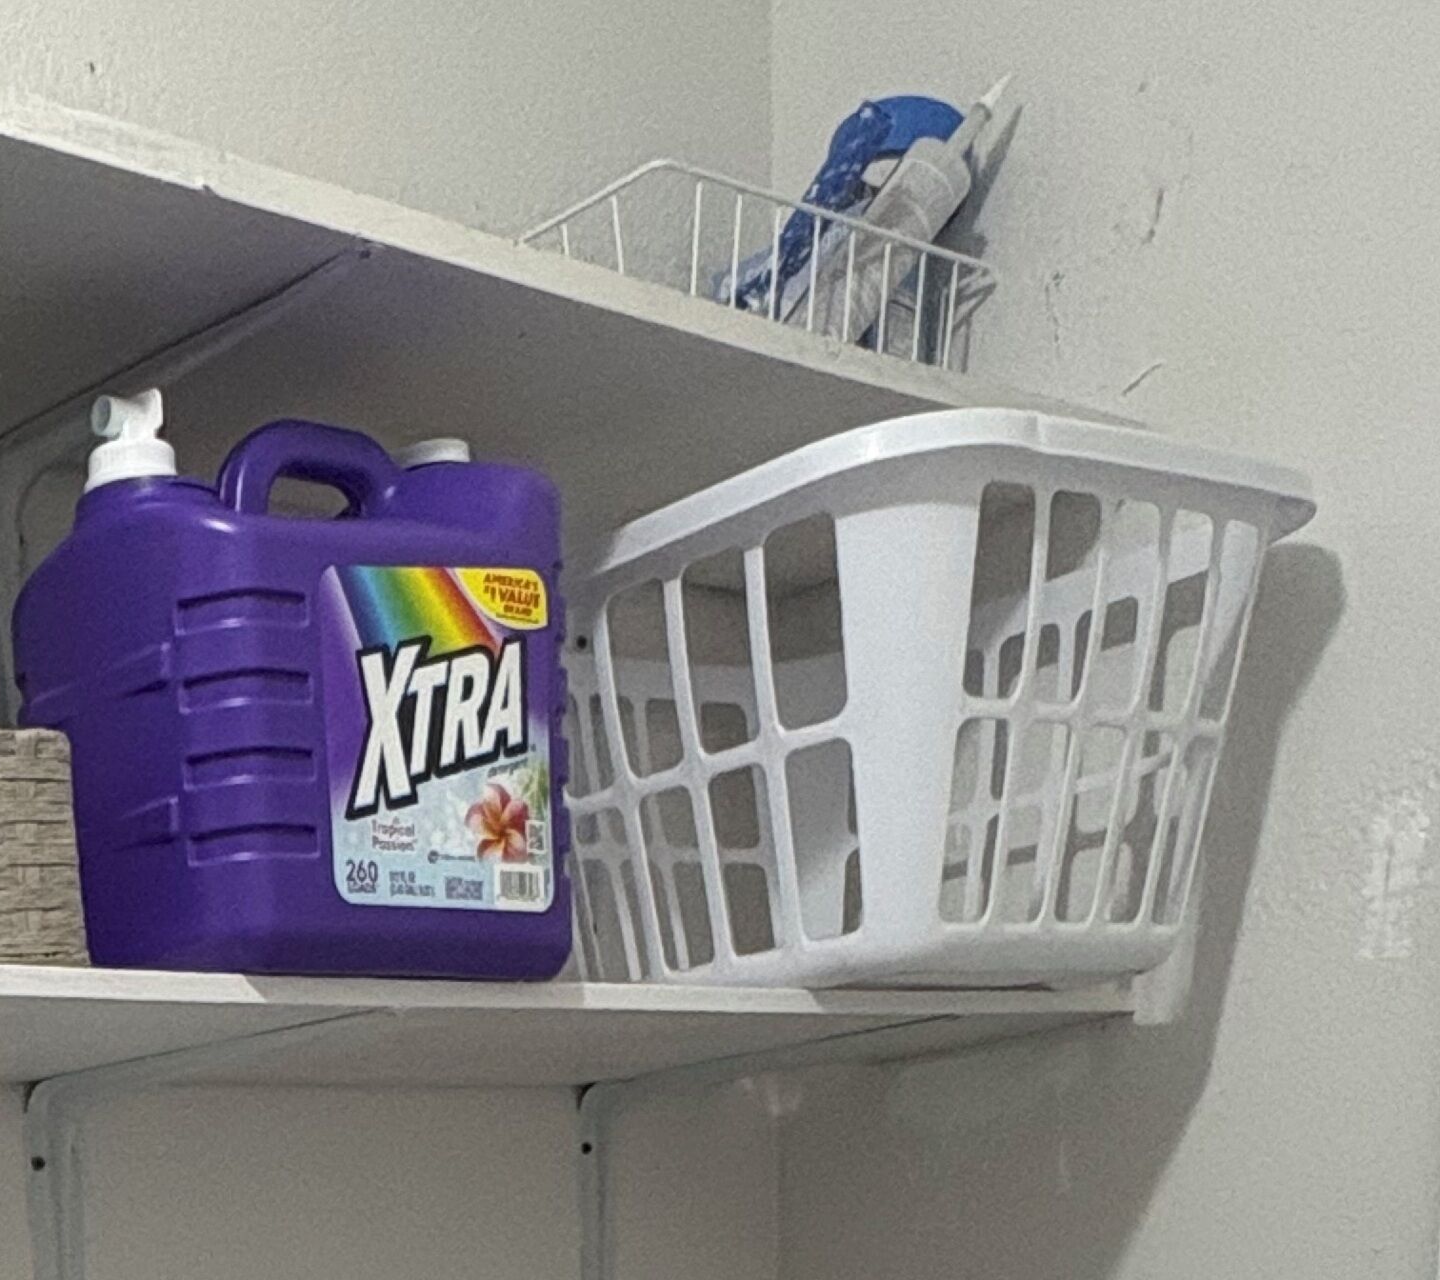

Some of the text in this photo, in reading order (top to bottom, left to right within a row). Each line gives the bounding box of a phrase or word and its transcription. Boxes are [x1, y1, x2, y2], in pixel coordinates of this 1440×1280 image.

[499, 588, 540, 609] VALUE
[353, 640, 523, 811] XTRA
[346, 859, 378, 882] 260
